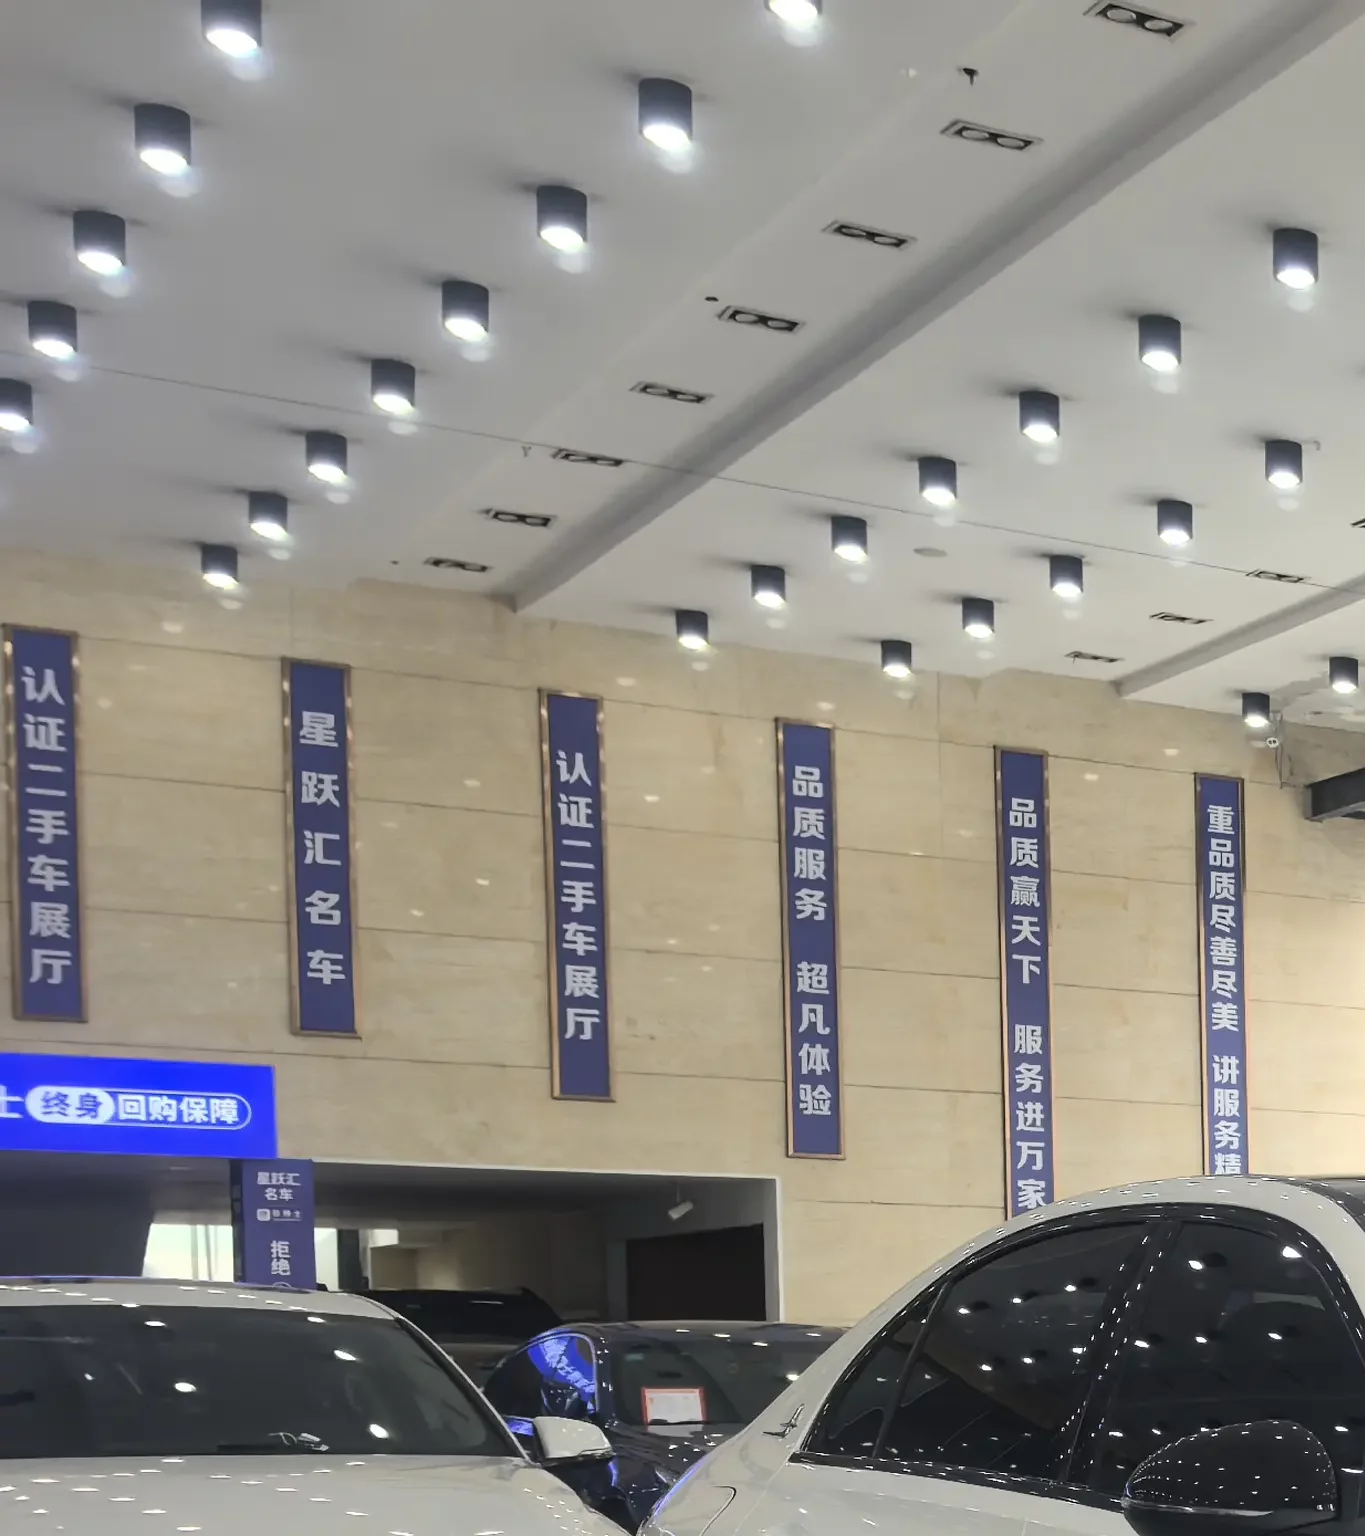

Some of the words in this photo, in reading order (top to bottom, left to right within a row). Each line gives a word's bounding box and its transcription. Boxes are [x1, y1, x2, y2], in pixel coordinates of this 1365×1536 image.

[21, 664, 72, 986] 认证二手车展厅
[299, 710, 346, 986] 星跃汇名车
[555, 750, 601, 1041] 认证二手车展厅
[791, 765, 829, 921] 品质服务
[1009, 796, 1041, 984] 品质赢天下
[1207, 804, 1240, 1032] 重品质尽善尽美
[796, 961, 832, 1117] 超凡体验
[1014, 1024, 1047, 1209] 服务进万家
[257, 1171, 301, 1186] 星跃汇
[264, 1188, 294, 1201] 名车
[270, 1240, 291, 1276] 拒绝
